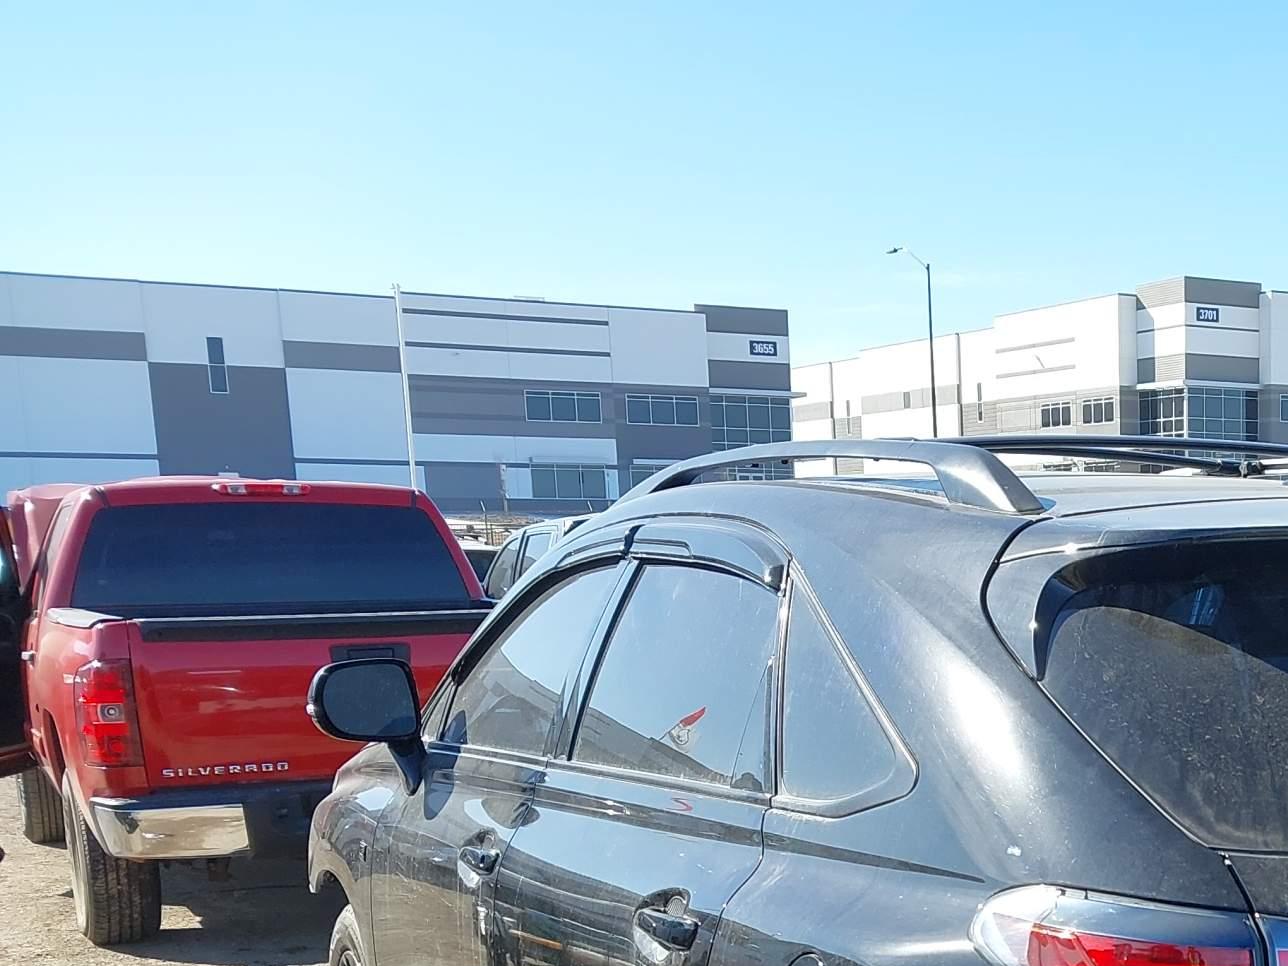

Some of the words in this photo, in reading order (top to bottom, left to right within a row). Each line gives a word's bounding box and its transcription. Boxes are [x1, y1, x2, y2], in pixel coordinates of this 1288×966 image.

[1199, 309, 1217, 321] 3701
[752, 342, 775, 355] 3655
[162, 762, 289, 778] SILVERADO
